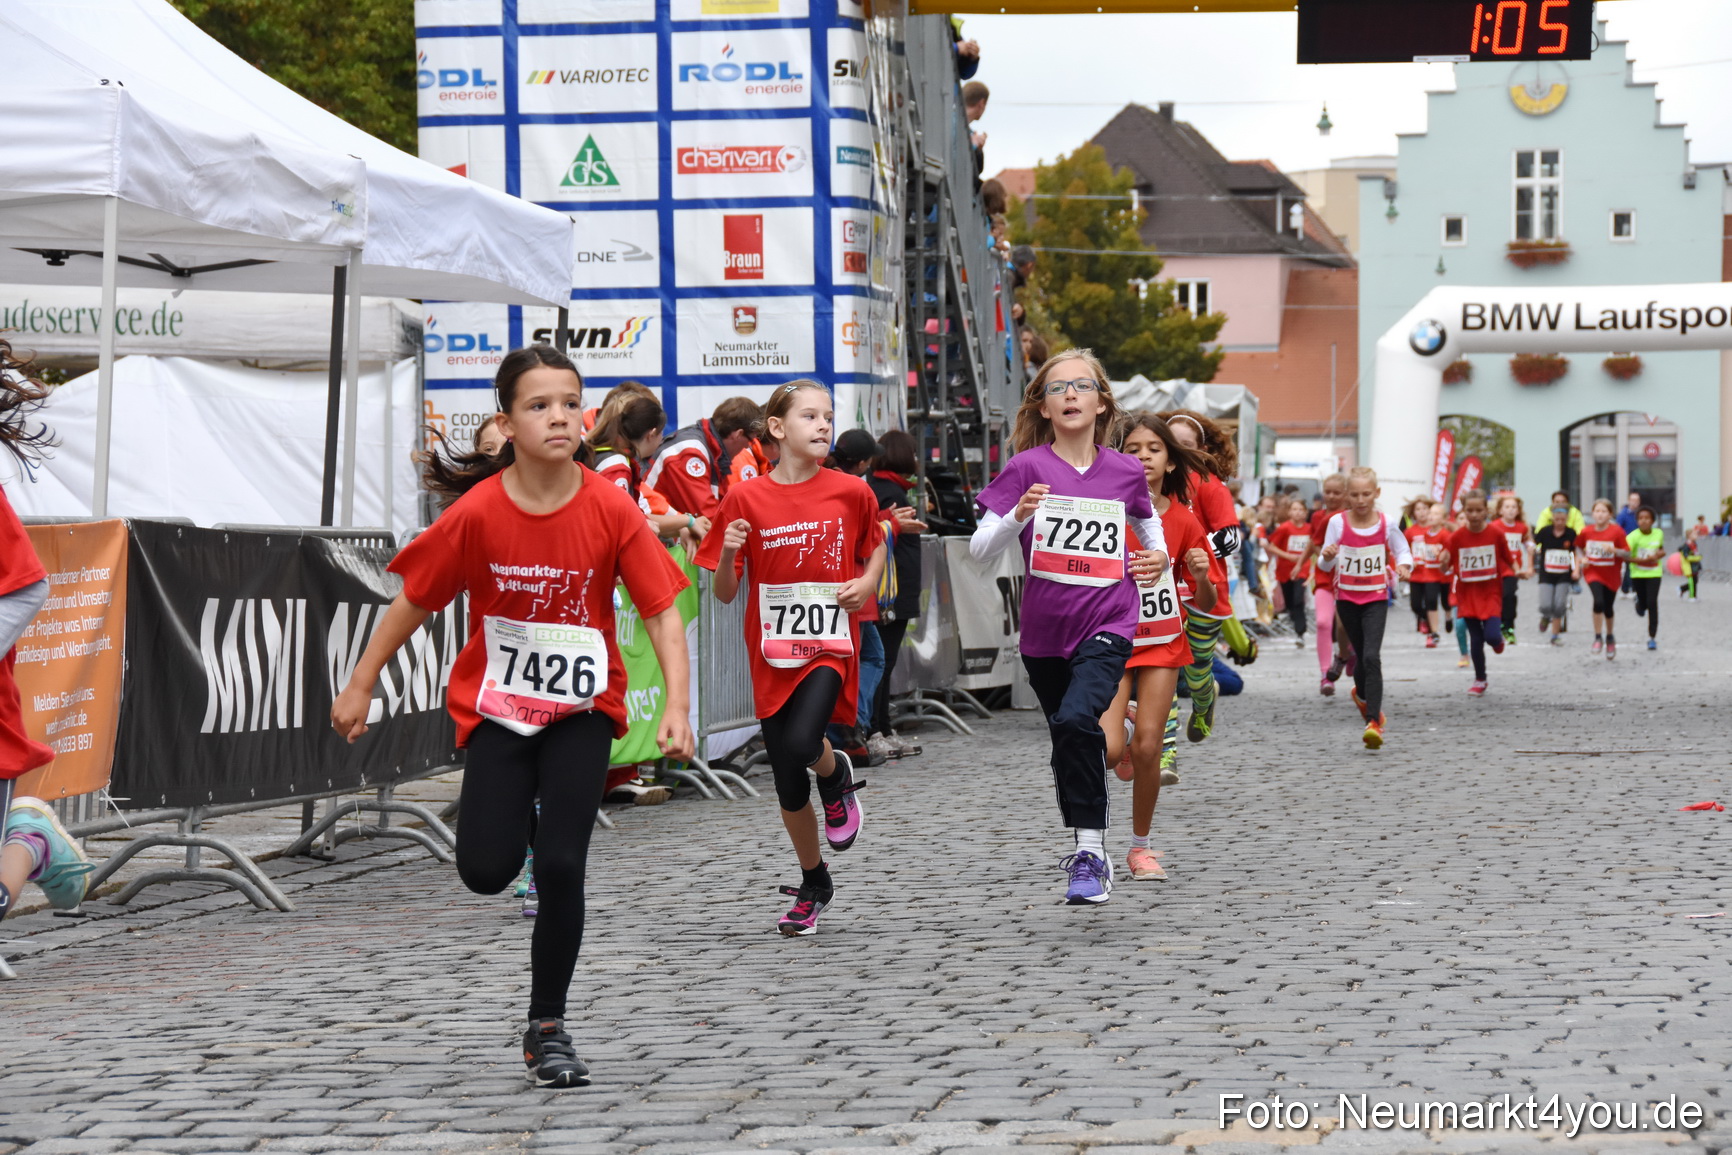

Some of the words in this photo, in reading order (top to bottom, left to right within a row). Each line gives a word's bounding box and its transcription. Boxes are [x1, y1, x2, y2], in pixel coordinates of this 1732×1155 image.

[1470, 0, 1570, 54] 1:05
[559, 67, 650, 84] VARIOTEC
[439, 84, 497, 100] energie
[745, 78, 803, 95] energie
[681, 145, 772, 168] charivari
[724, 250, 761, 268] Braun
[1461, 303, 1563, 331] BMW
[714, 340, 779, 352] Neumarkter
[587, 350, 634, 361] neumarkt
[703, 352, 790, 367] Lammsbräu
[1432, 437, 1453, 502] REWE
[1080, 501, 1120, 515] BOCK
[759, 521, 819, 538] Neumarkter
[1045, 516, 1119, 554] 7223
[762, 534, 808, 550] Stadtlauf
[1067, 559, 1090, 573] Ella
[1344, 556, 1381, 574] 7194
[1462, 554, 1493, 570] 7217
[80, 566, 110, 582] Partner
[64, 591, 77, 608] und
[769, 603, 841, 635] 7207
[36, 617, 63, 641] Projekte
[63, 620, 80, 633] was
[495, 628, 529, 642] NeuerMarkt
[535, 627, 595, 643] BOCK
[14, 642, 51, 666] rafikdesign
[51, 641, 66, 659] und
[791, 644, 825, 656] Elena
[200, 597, 307, 734] MINI
[499, 644, 596, 699] 7426
[33, 692, 60, 712] Melden
[78, 733, 93, 750] 897
